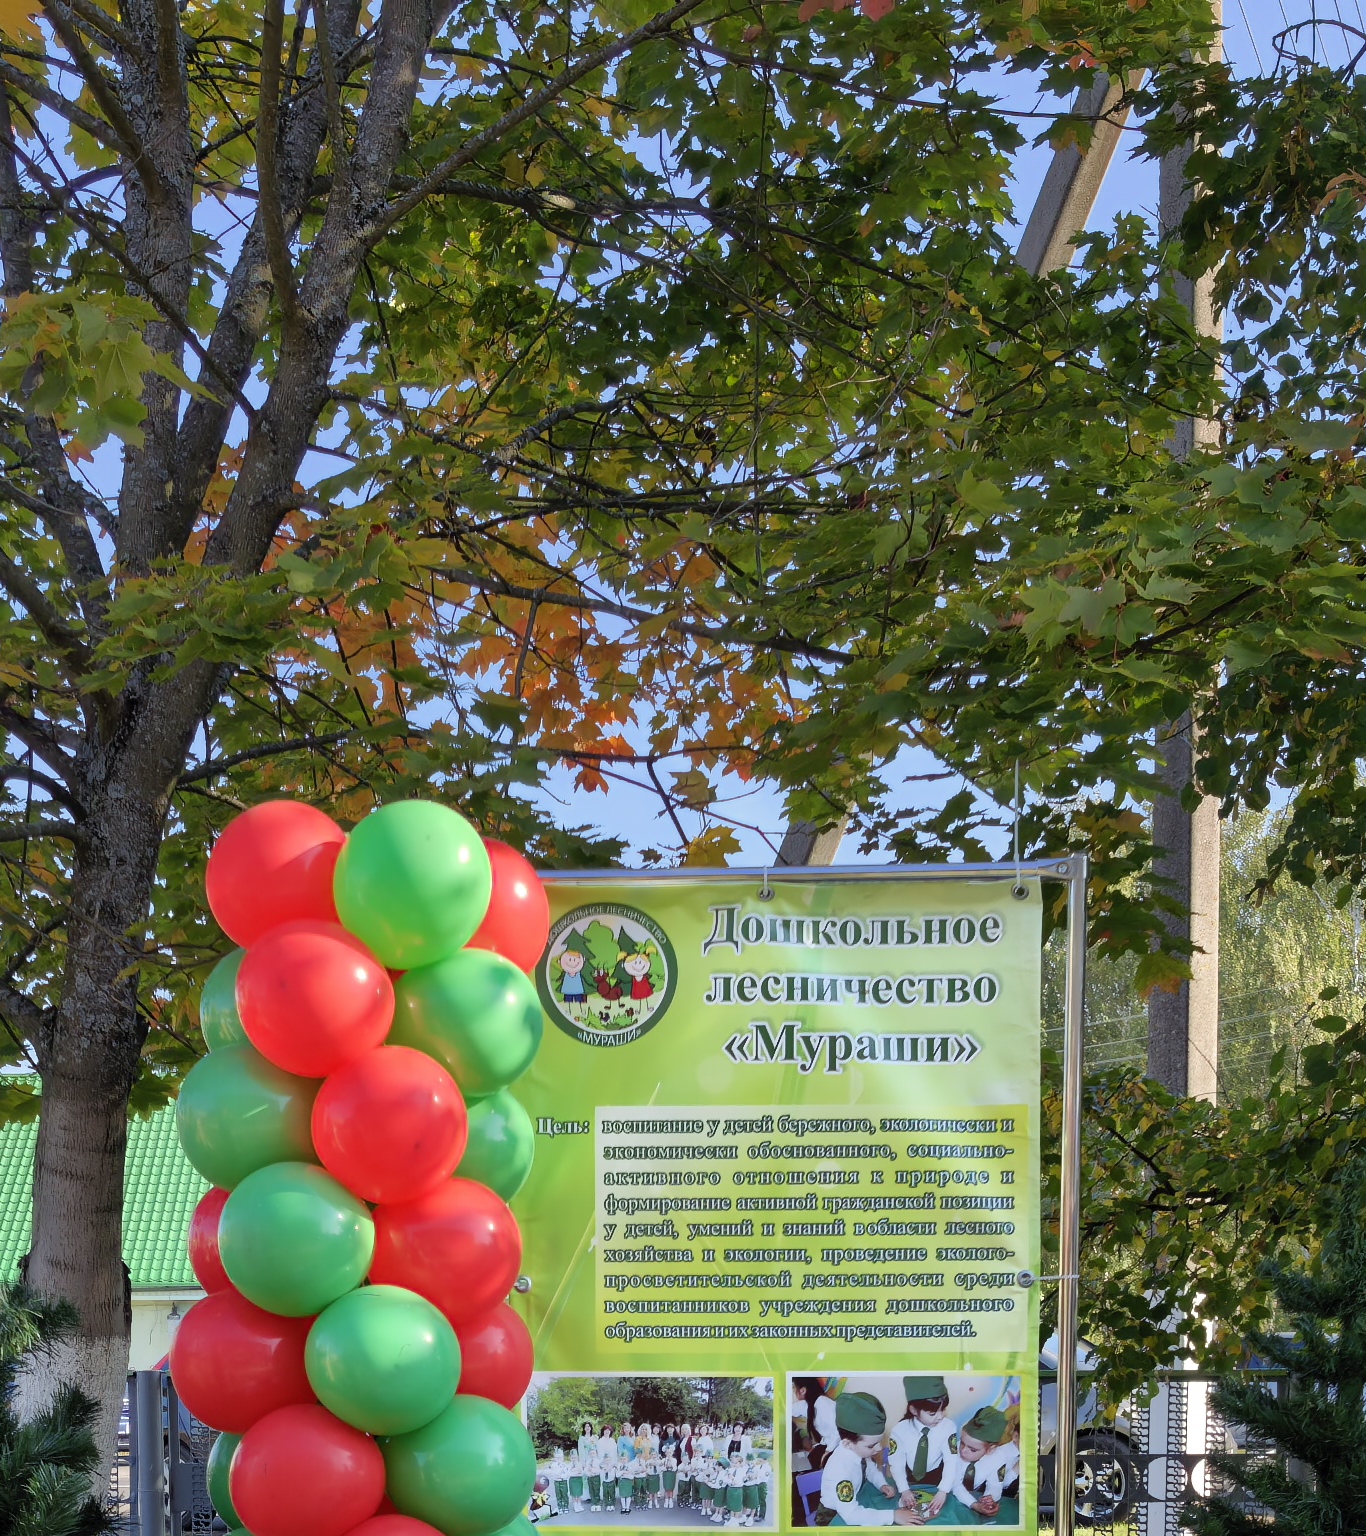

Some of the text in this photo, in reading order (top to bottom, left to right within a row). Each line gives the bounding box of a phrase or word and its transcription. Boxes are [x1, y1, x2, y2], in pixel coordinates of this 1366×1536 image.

[703, 905, 1003, 955] Дошкольное
[705, 972, 999, 1006] лесничество
[577, 1028, 642, 1047] «МУРАШИ»
[722, 1022, 982, 1074] «Мураши»
[536, 1115, 1014, 1137] Цель: воспитание у детей бережного, экологически и
[603, 1141, 1014, 1161] экономически обоснованного, социально-
[603, 1170, 1014, 1187] активного отношения к природе и
[604, 1192, 1014, 1215] формирование активной гражданской позиции
[604, 1223, 617, 1240] у
[624, 1220, 679, 1239] детей,
[687, 1219, 753, 1240] умений
[762, 1223, 775, 1236] и
[783, 1219, 845, 1236] знаний
[945, 1222, 1014, 1235] лесного
[604, 1246, 1014, 1265] хозяйства и экологии, проведение эколого-
[604, 1271, 1014, 1291] просветительской деятельности среди
[604, 1299, 1014, 1316] воспитанников учреждения дошкольного
[605, 1321, 713, 1342] образования
[751, 1325, 834, 1338] законных
[836, 1321, 976, 1341] представителей.
